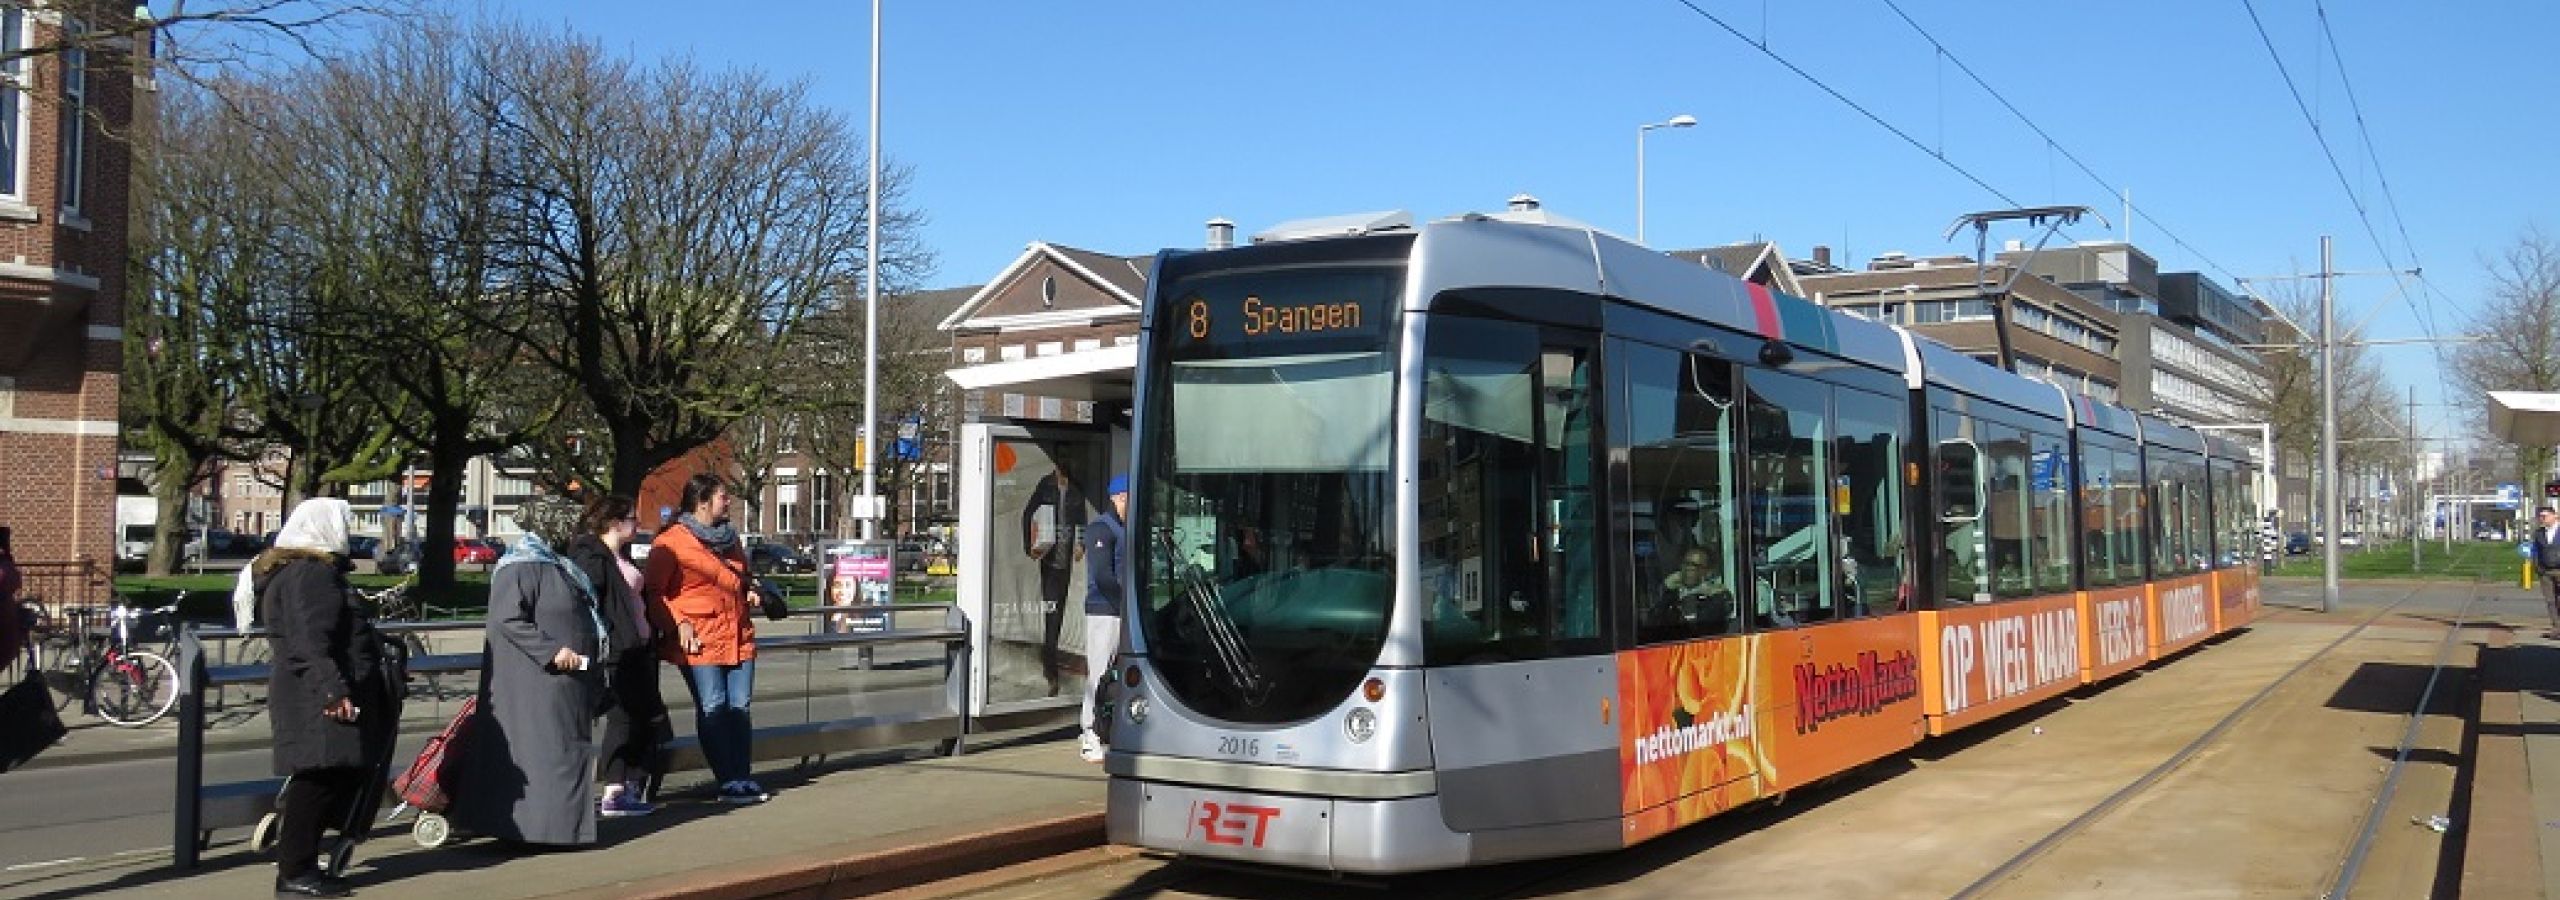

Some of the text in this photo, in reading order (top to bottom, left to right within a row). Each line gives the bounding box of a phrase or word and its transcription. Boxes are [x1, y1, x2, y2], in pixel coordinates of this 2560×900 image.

[1190, 296, 1360, 339] 8 Spangen
[1942, 625, 1974, 714] OP
[1979, 616, 2028, 702] WEG
[2031, 607, 2079, 686] NAAR
[1218, 736, 1260, 757] 2016
[1634, 703, 1751, 766] nettomarkt.nl
[1196, 801, 1282, 849] RET
